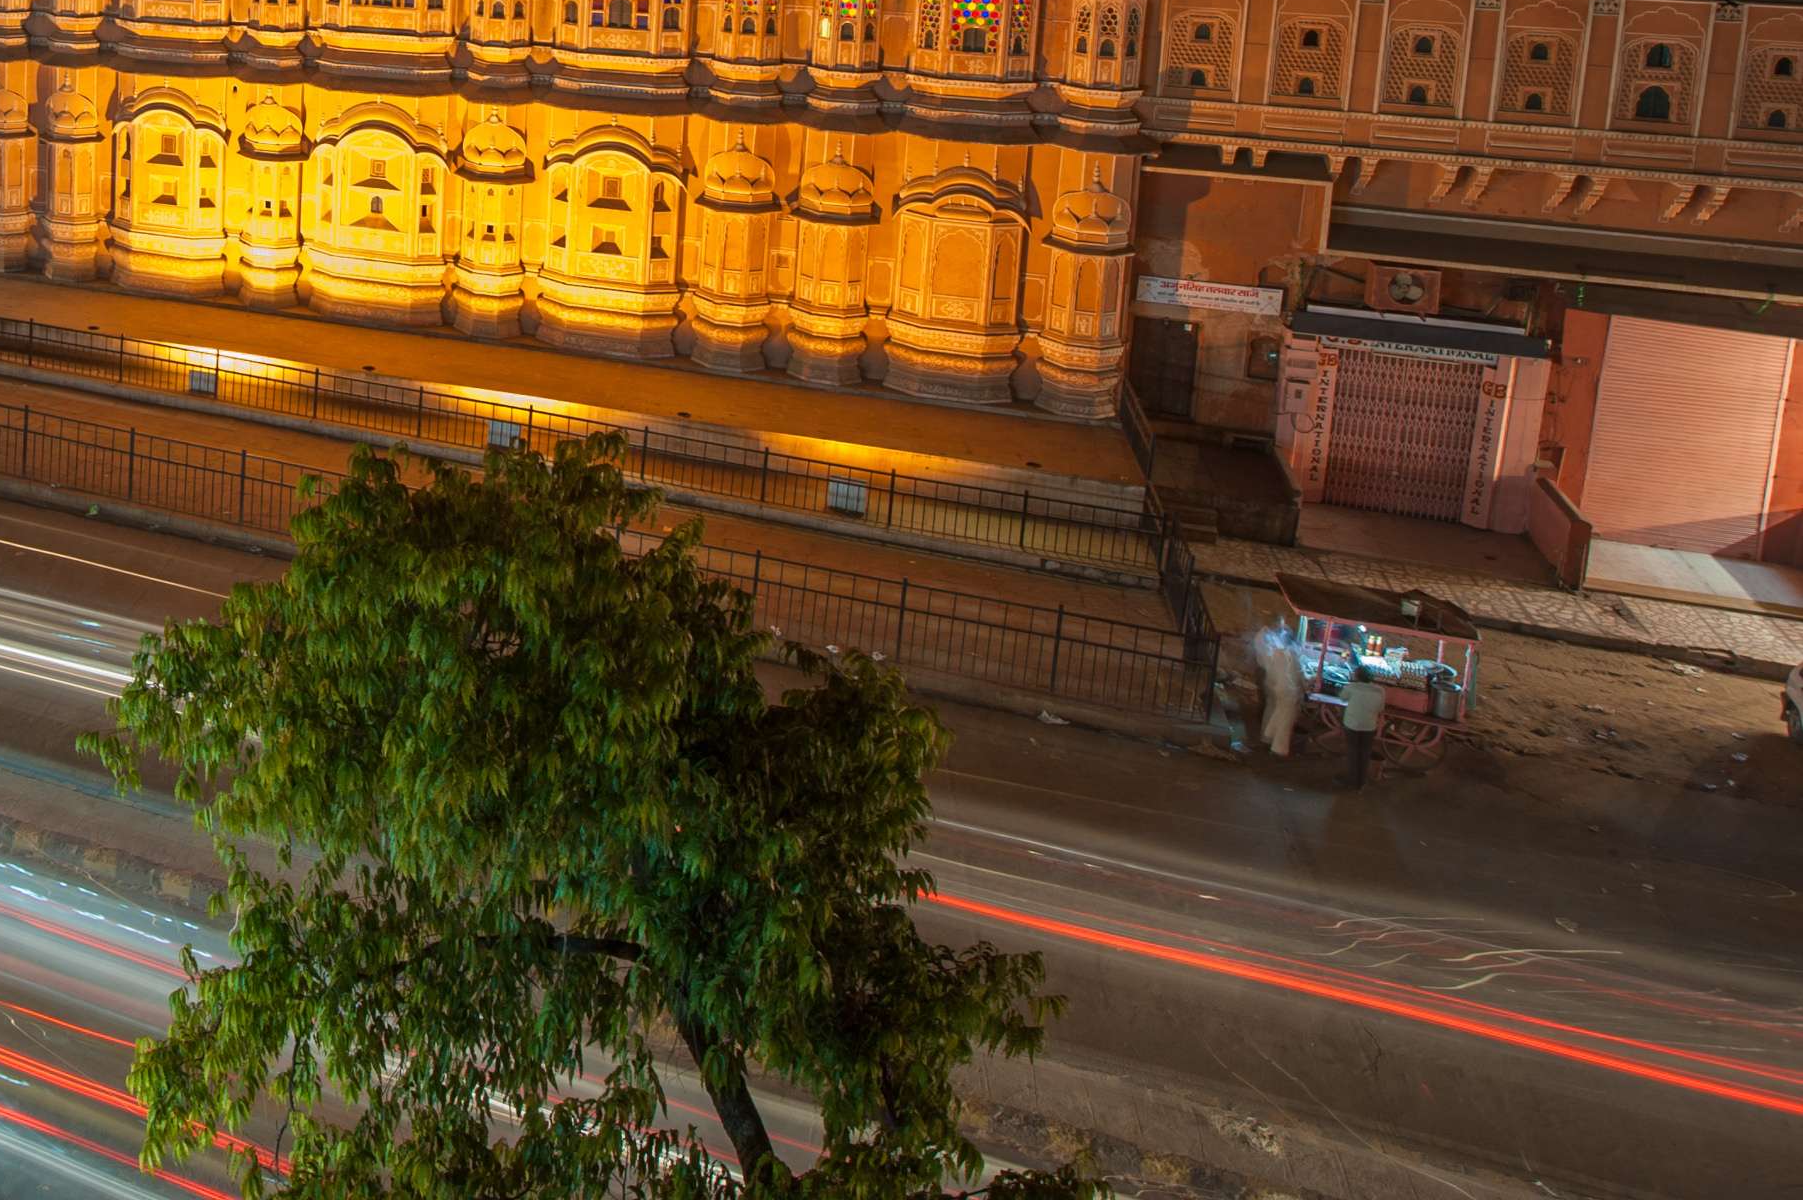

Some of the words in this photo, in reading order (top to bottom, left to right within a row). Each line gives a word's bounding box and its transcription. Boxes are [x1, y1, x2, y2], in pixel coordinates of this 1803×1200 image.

[1309, 369, 1329, 481] INTERNATIONAL
[1482, 381, 1507, 398] GB
[1470, 399, 1495, 515] INTERNATIONAL
